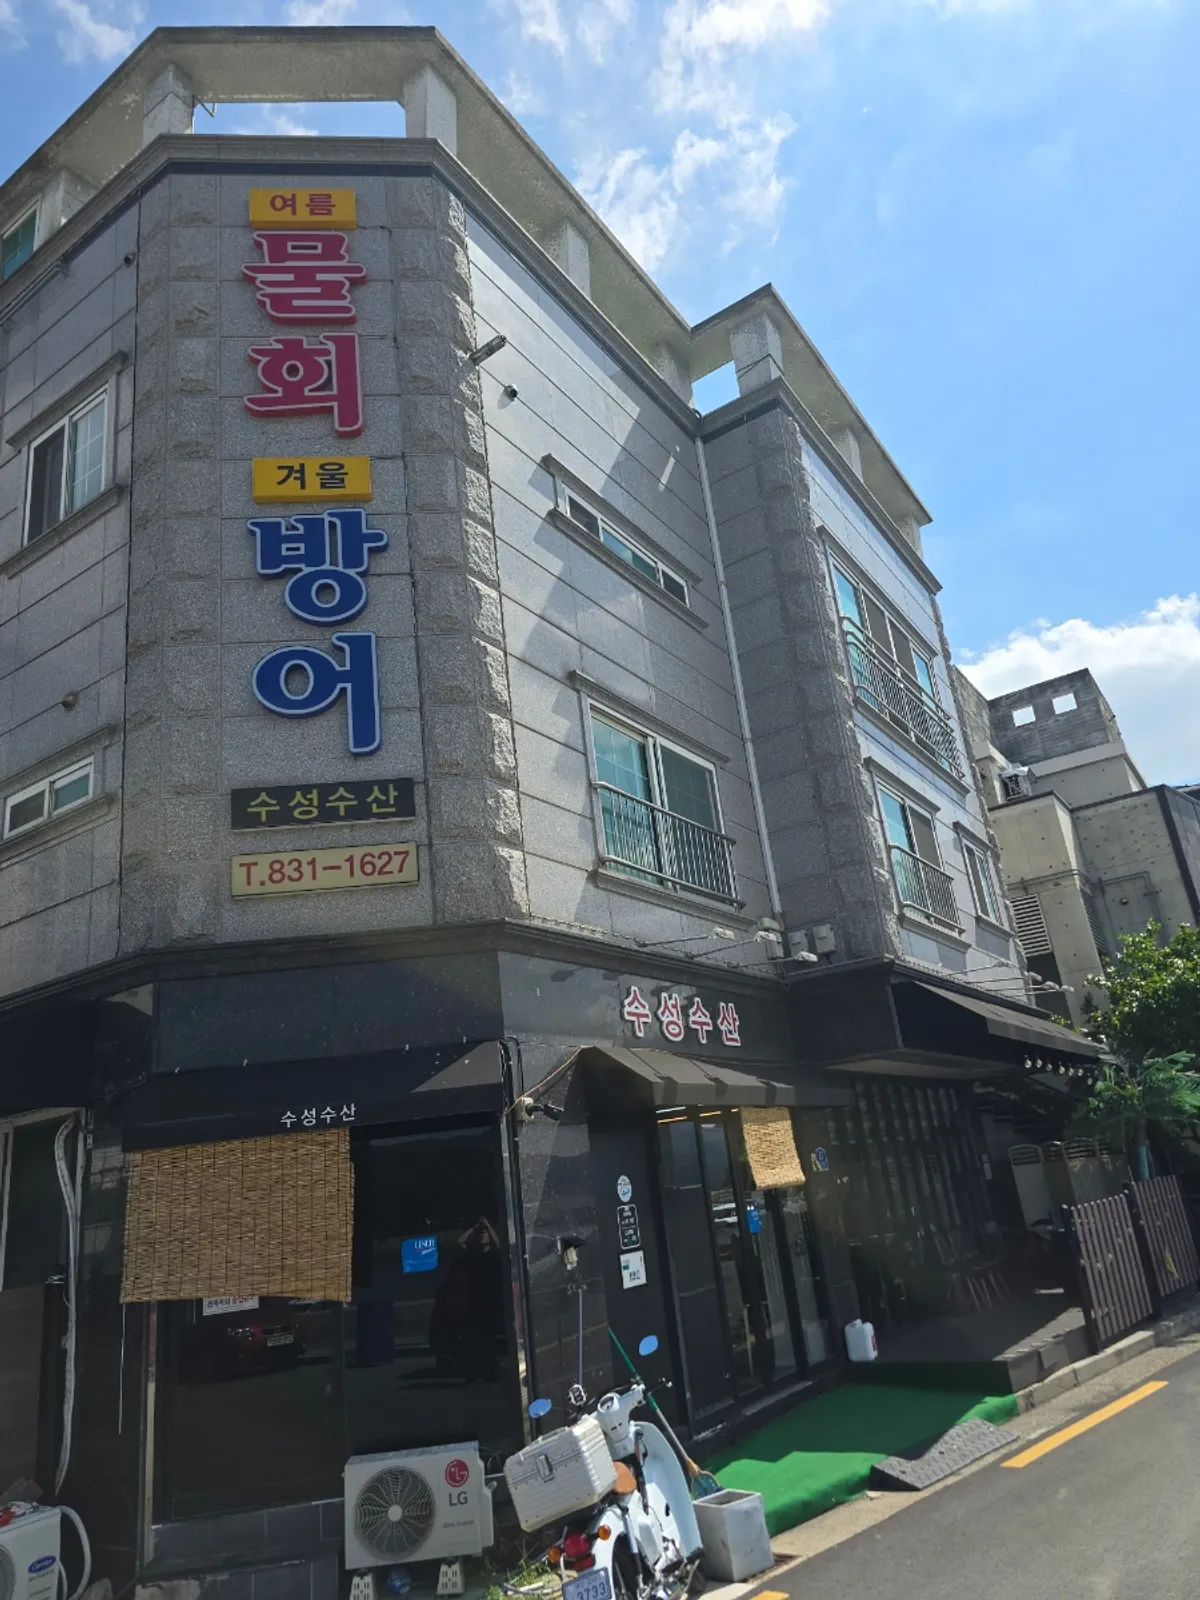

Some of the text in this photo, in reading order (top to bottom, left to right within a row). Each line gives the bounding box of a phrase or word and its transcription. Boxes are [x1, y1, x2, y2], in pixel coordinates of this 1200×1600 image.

[269, 193, 336, 216] 여름
[242, 230, 369, 439] 물회
[276, 462, 349, 490] 겨울
[245, 507, 389, 757] 방어
[246, 783, 399, 823] 수성수산
[239, 850, 410, 887] T.831-1627
[623, 985, 741, 1047] 수성수산
[280, 1102, 357, 1129] 수성수산
[448, 1491, 469, 1507] LG
